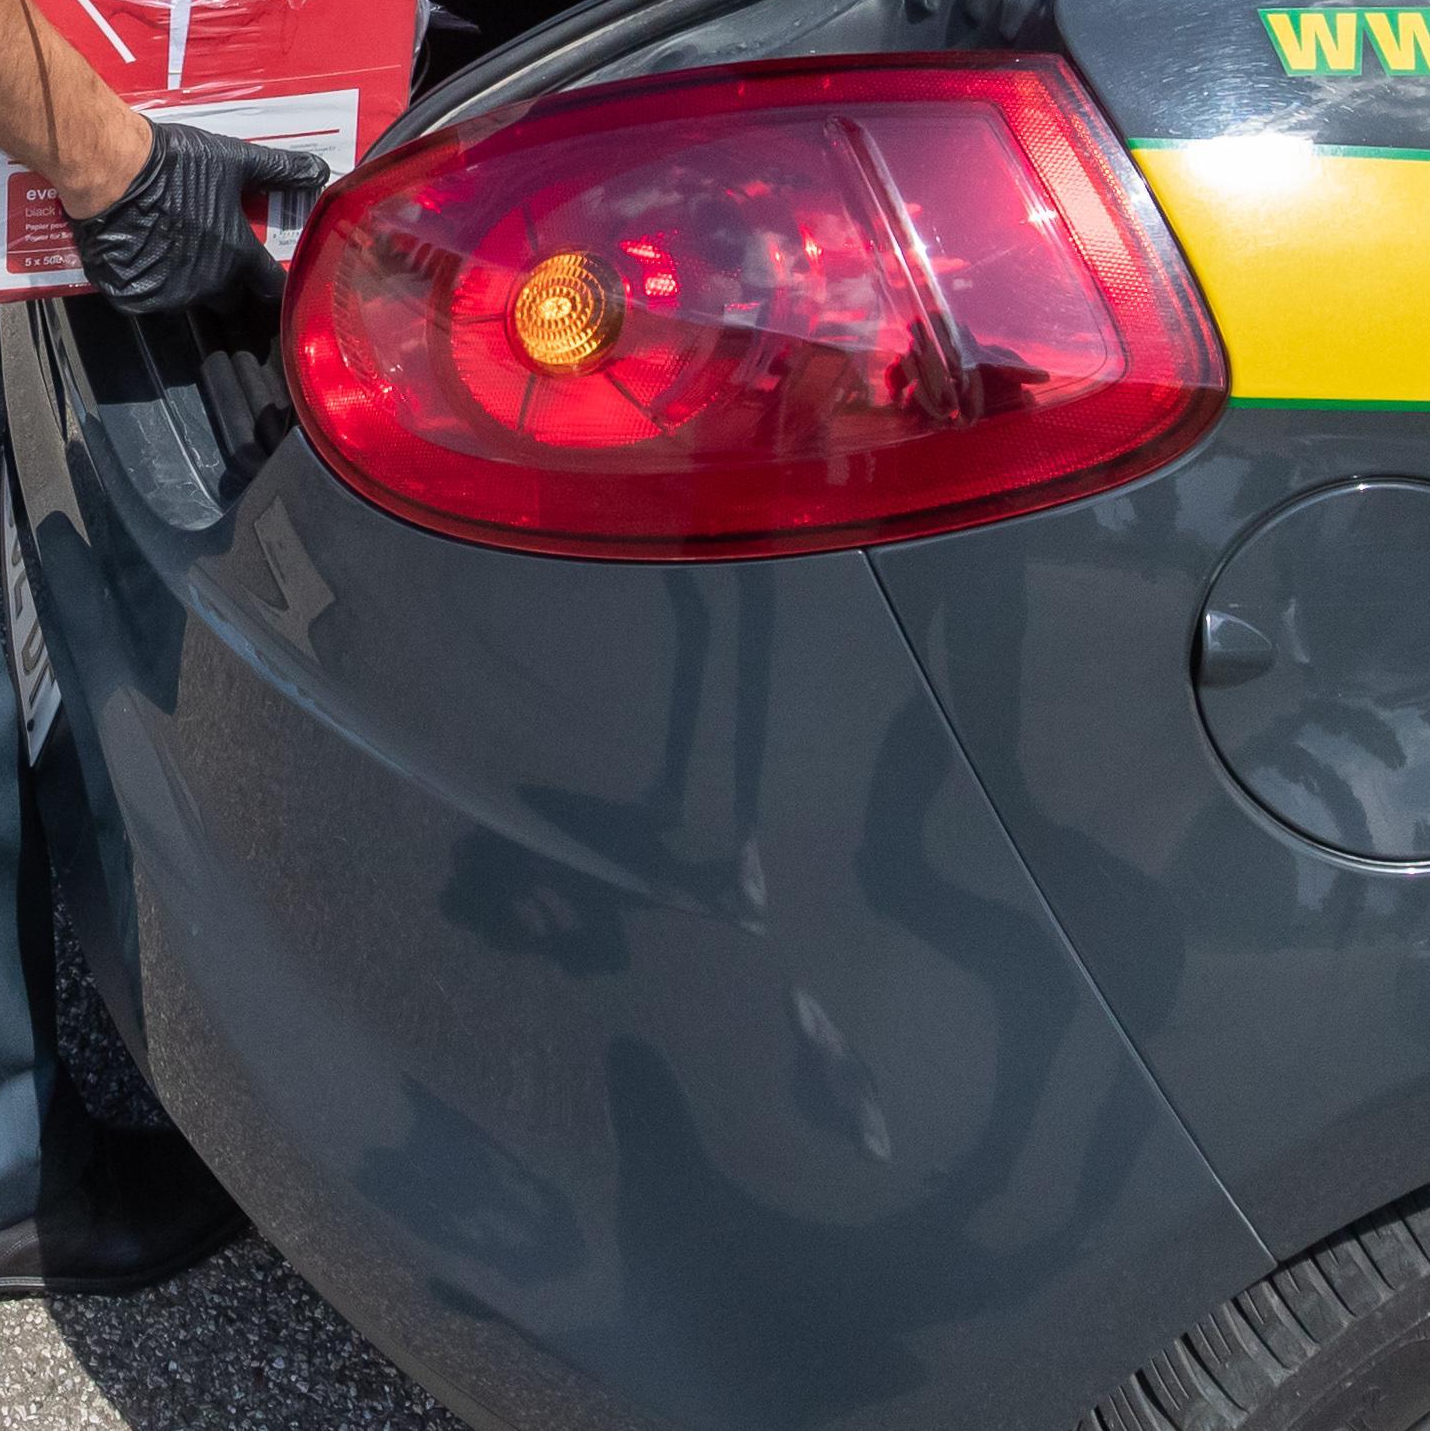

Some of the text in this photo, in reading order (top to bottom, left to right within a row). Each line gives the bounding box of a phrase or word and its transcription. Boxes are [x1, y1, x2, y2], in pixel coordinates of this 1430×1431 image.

[26, 187, 58, 201] eve
[25, 206, 56, 218] black
[25, 223, 49, 232] Papier
[25, 257, 32, 267] 5
[33, 258, 41, 266] x
